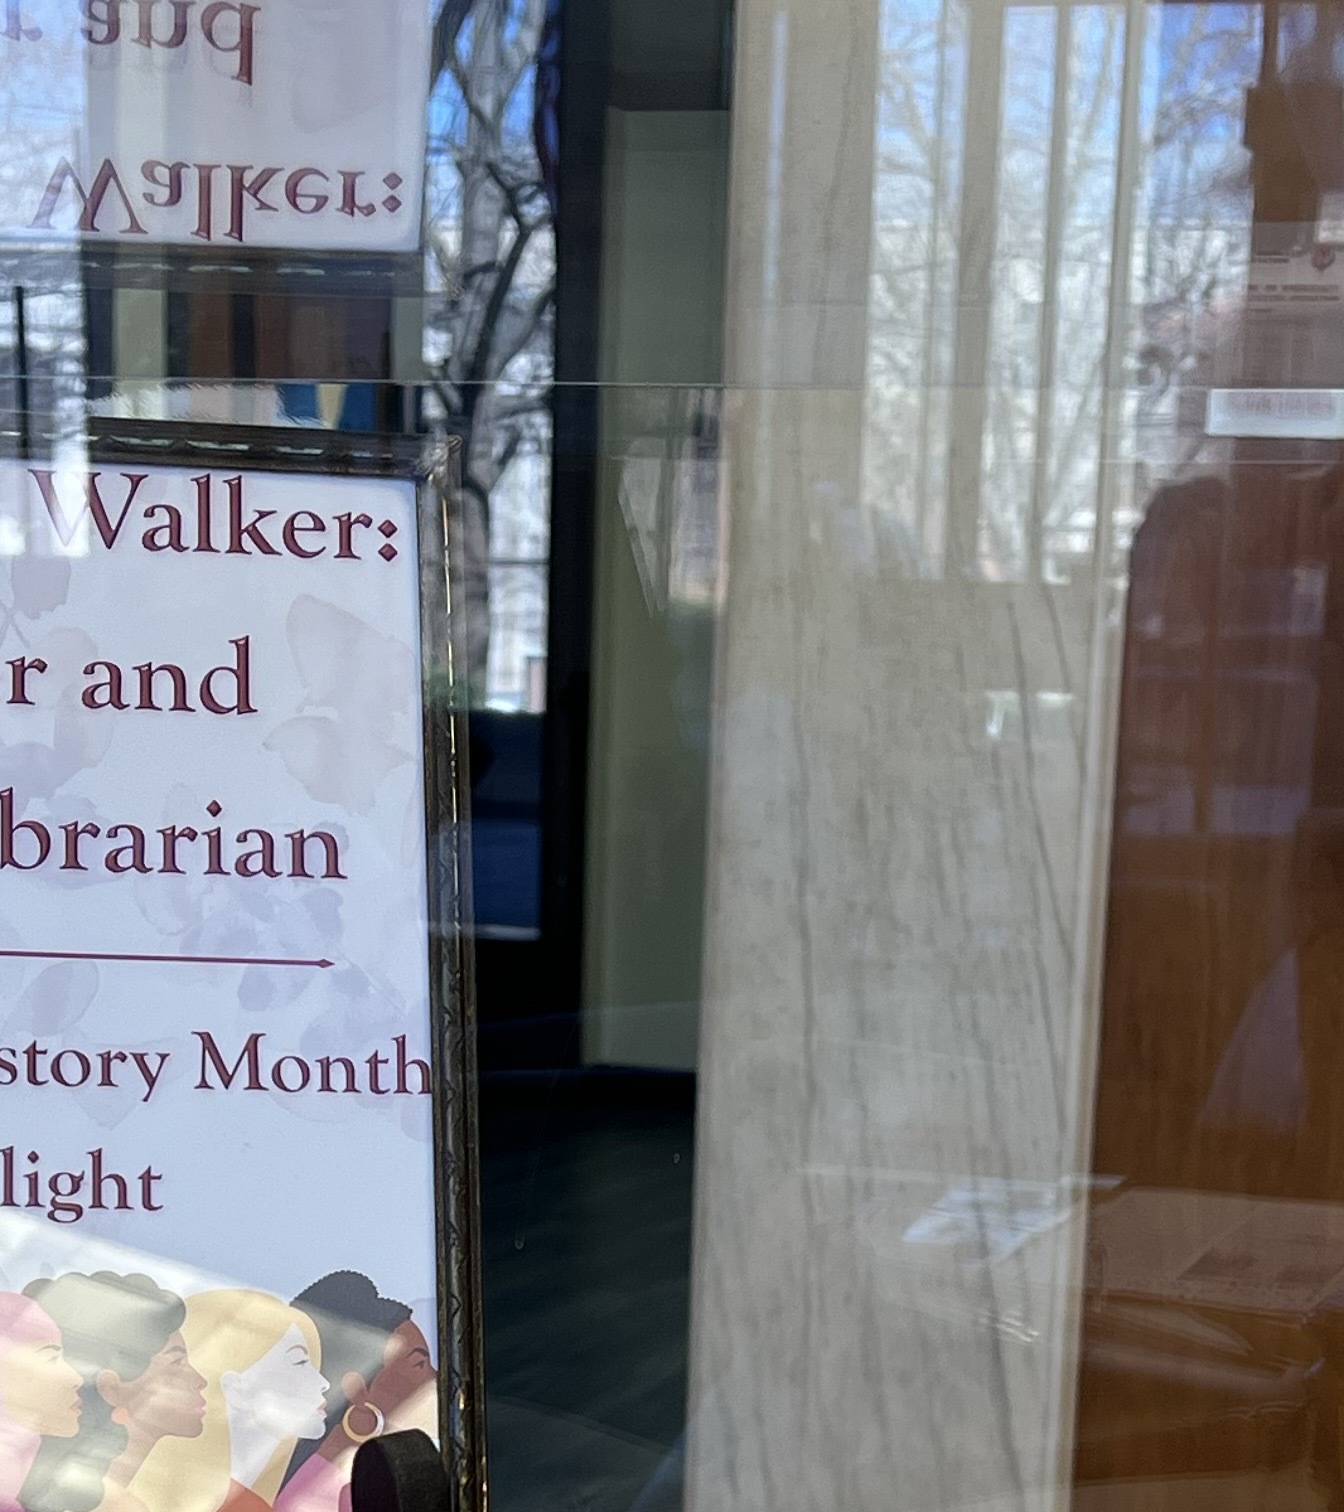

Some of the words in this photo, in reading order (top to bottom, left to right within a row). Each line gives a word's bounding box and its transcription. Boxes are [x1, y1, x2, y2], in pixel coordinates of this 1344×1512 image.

[27, 464, 402, 566] Walker:
[81, 634, 260, 718] and
[191, 1030, 434, 1097] Month
